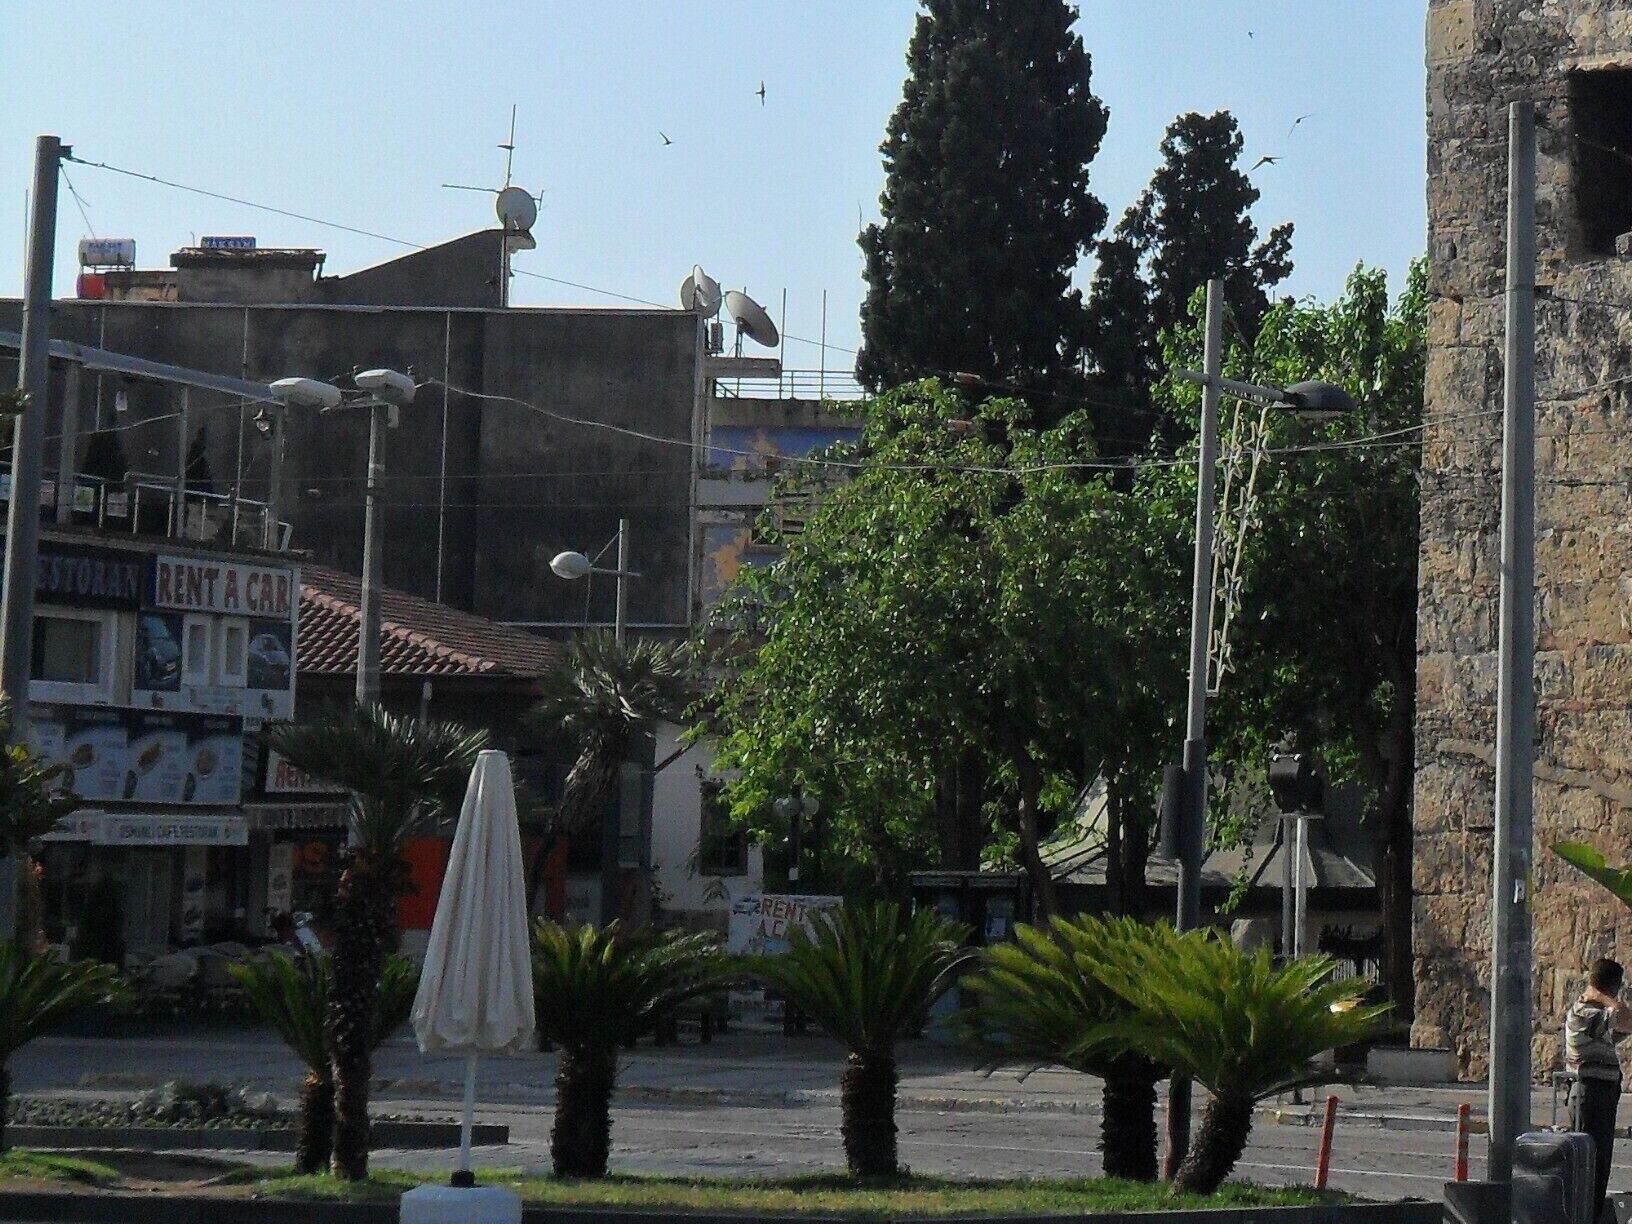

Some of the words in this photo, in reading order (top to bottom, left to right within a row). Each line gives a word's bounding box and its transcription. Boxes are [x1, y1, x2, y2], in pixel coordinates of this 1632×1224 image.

[36, 555, 139, 600] ESTORAN
[159, 562, 219, 607] RENT
[224, 568, 240, 609] A
[246, 571, 289, 613] CAR
